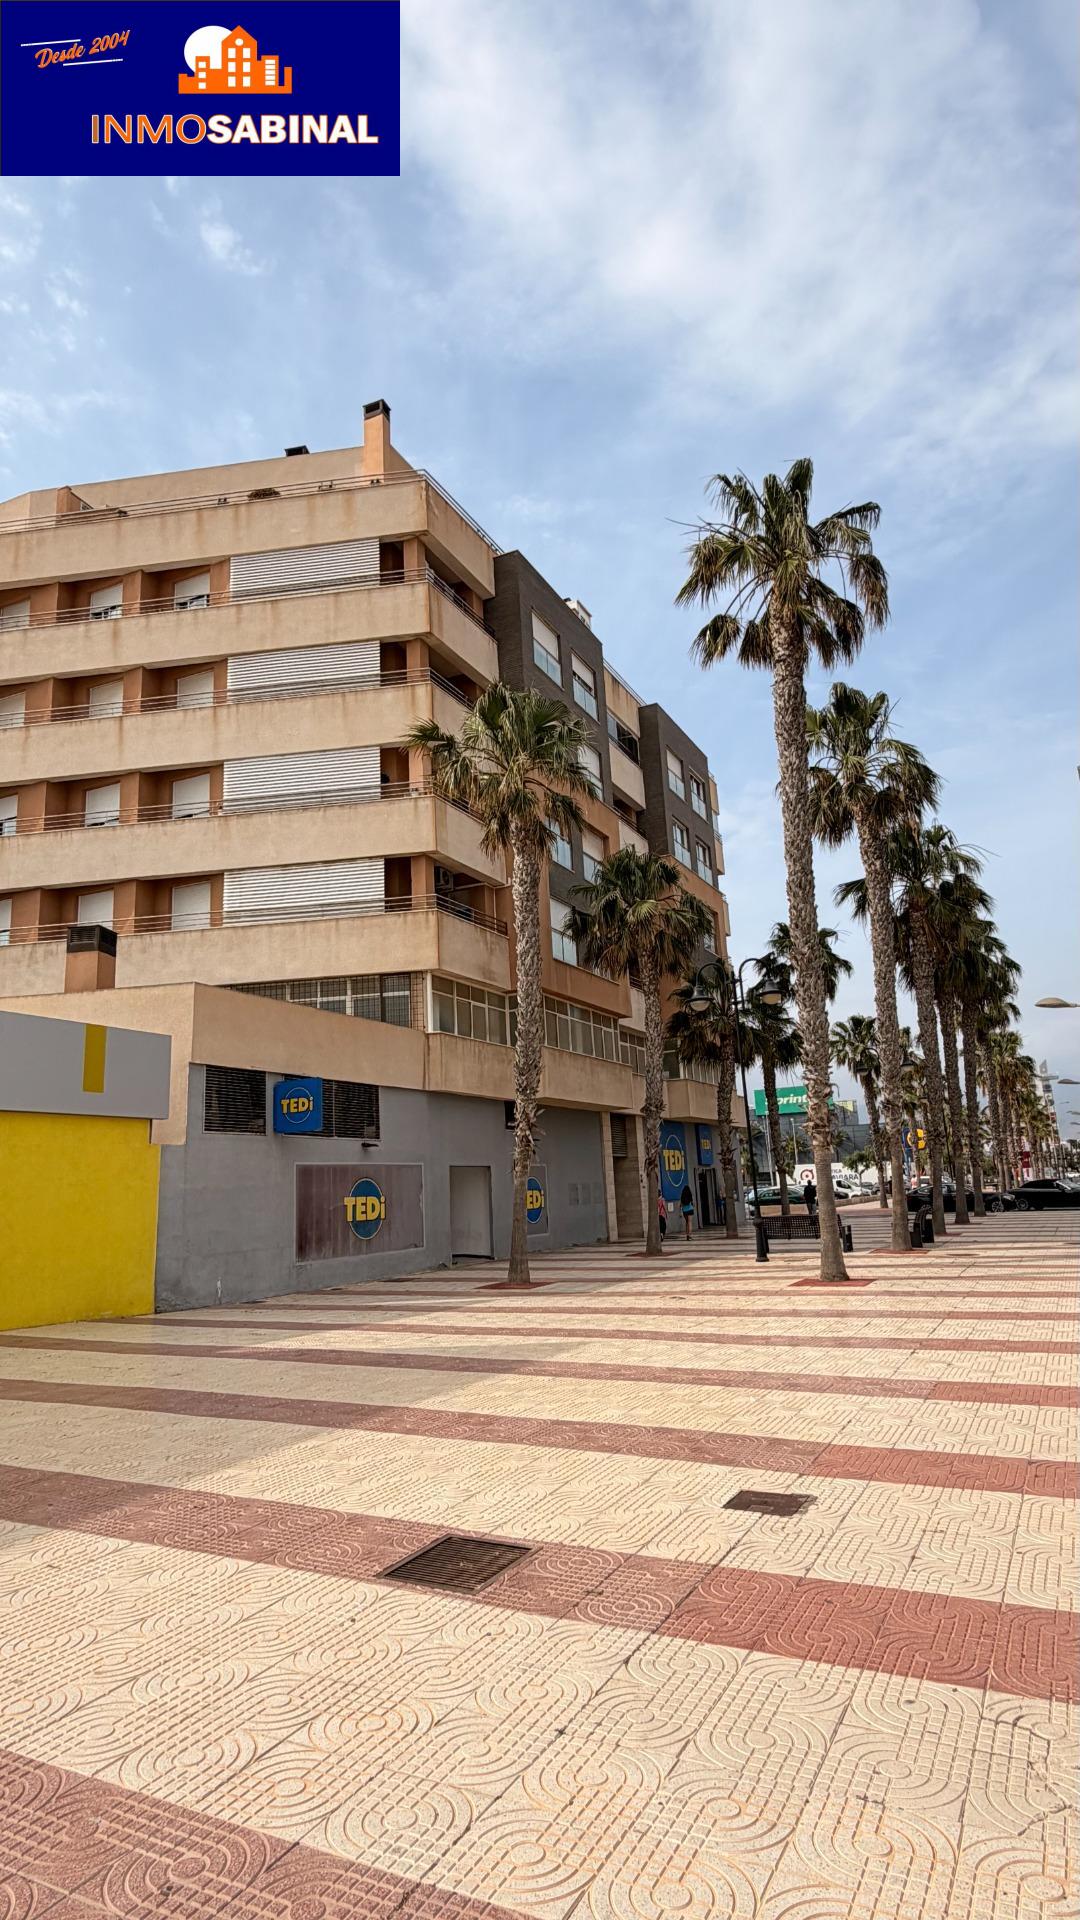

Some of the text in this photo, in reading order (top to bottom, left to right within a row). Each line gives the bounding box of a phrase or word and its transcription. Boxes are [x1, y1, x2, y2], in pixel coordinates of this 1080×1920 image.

[280, 1096, 314, 1114] TEDi
[662, 1149, 686, 1171] TEDi
[343, 1195, 386, 1222] TEDi
[522, 1183, 545, 1210] EDi
